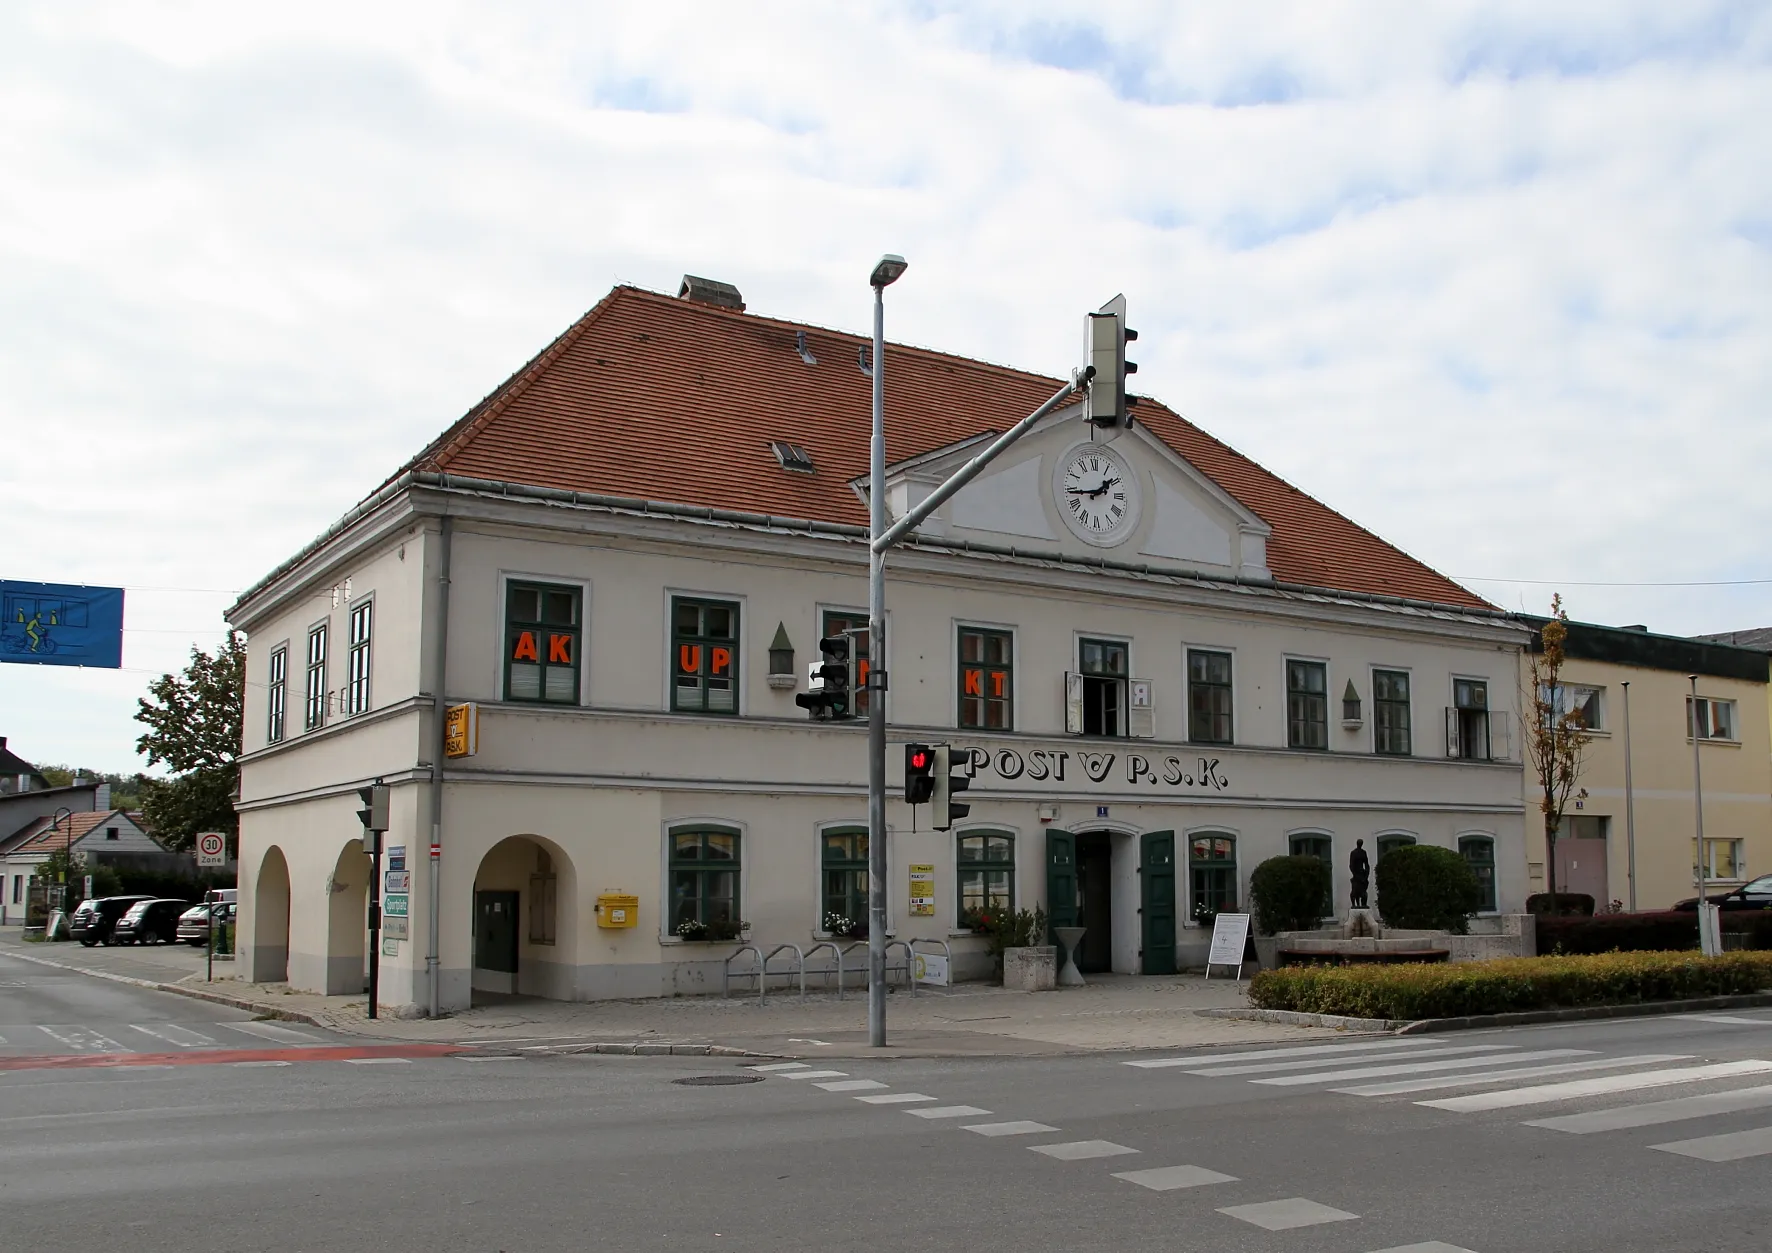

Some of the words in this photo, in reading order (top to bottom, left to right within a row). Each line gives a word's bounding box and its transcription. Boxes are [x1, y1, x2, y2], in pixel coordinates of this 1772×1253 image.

[1103, 465, 1110, 476] I
[1113, 492, 1123, 500] III
[447, 708, 464, 721] POST
[964, 746, 1070, 781] POST
[1126, 754, 1229, 791] P.S.K.
[206, 839, 218, 850] 30
[386, 898, 407, 912] Sportplatz
